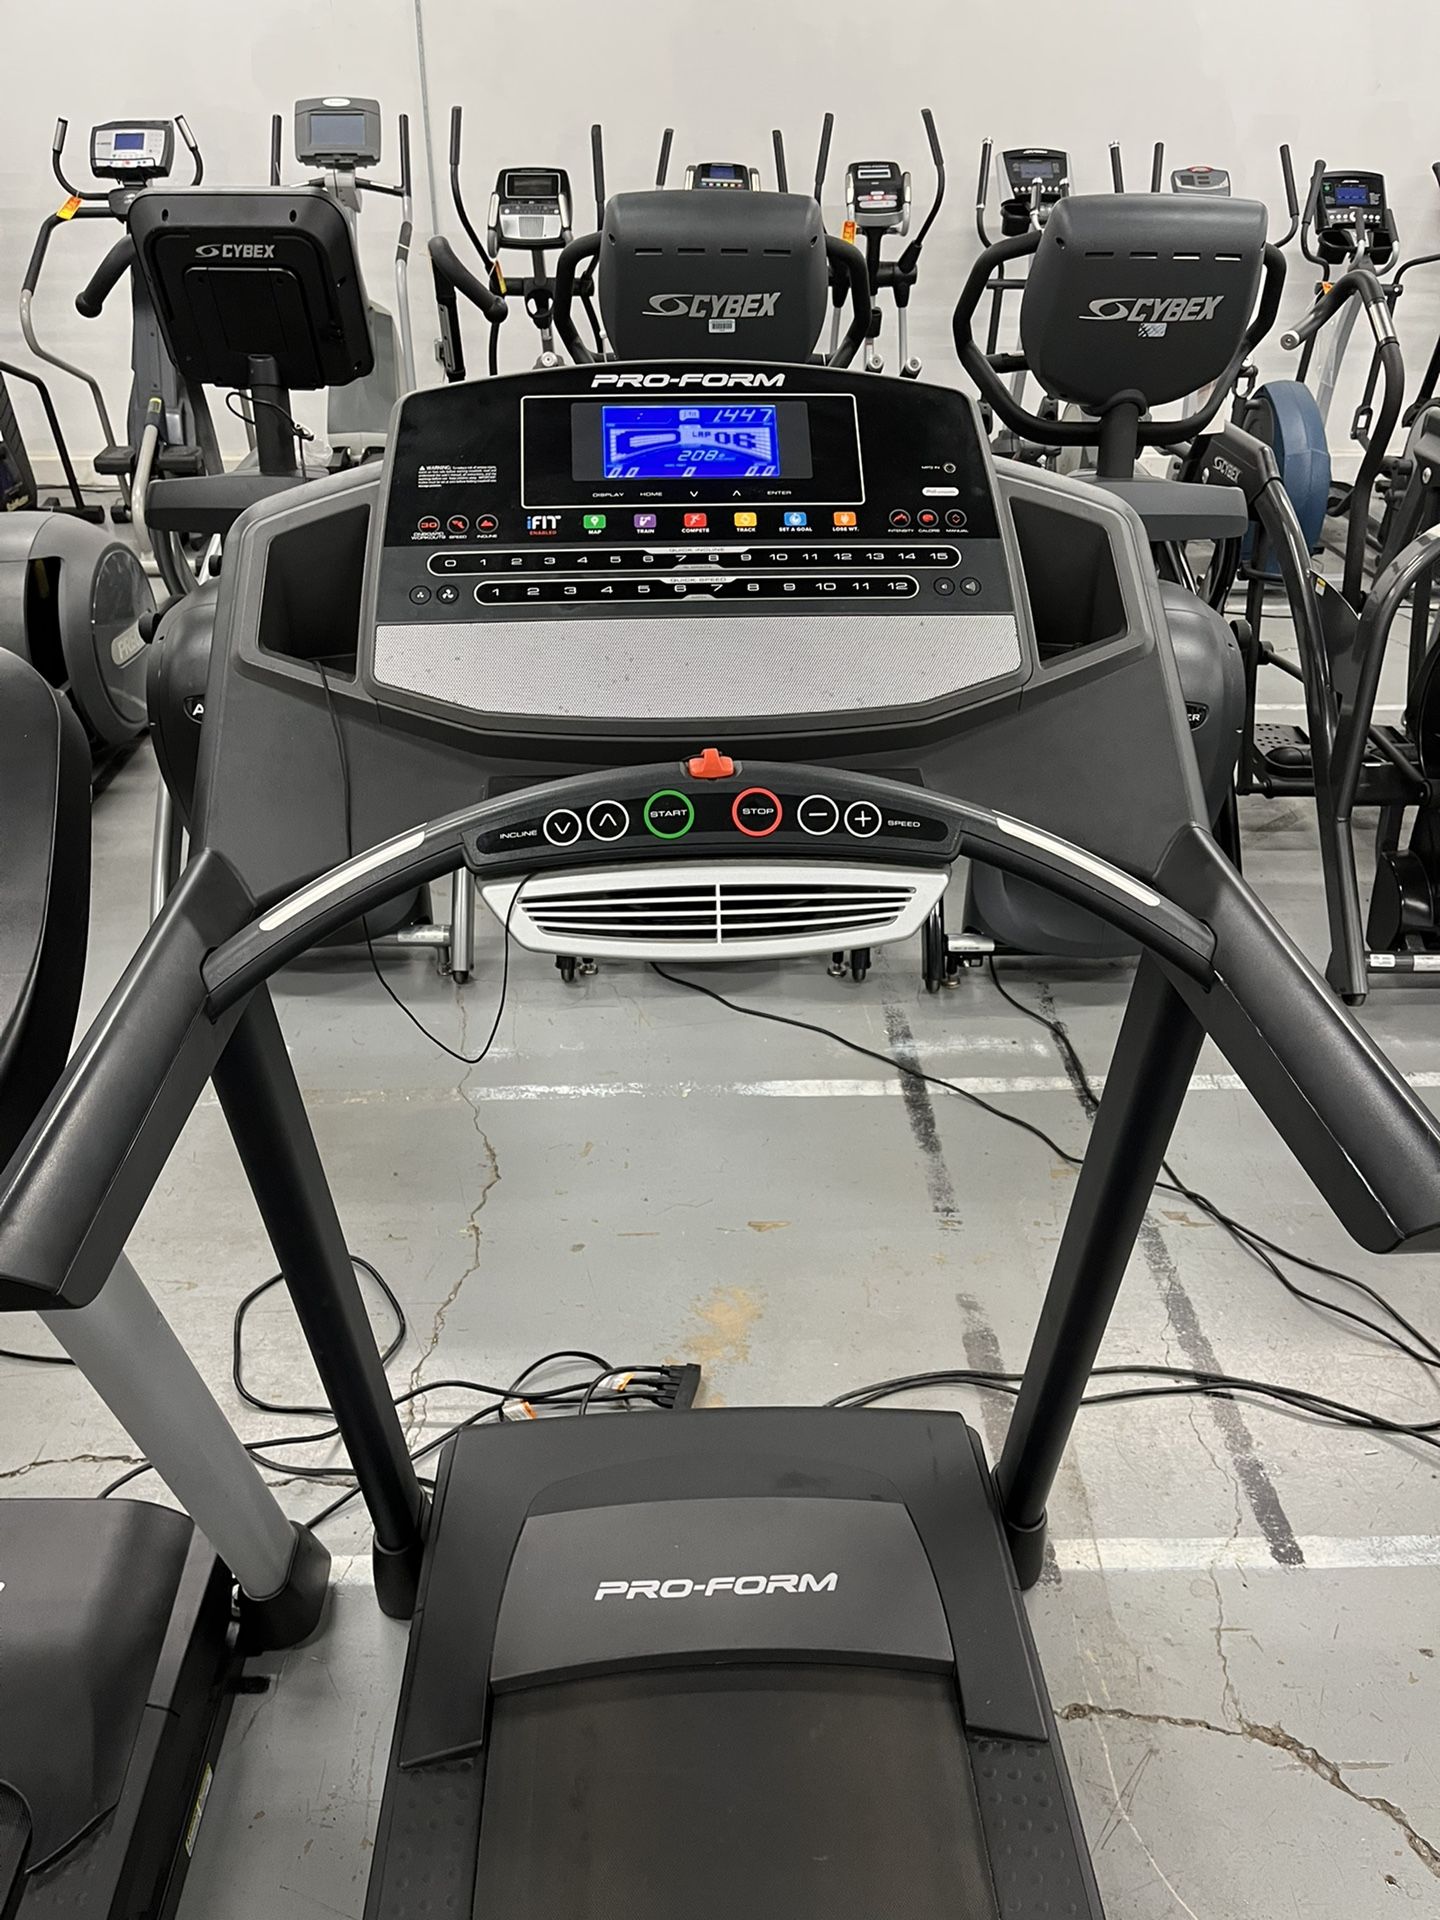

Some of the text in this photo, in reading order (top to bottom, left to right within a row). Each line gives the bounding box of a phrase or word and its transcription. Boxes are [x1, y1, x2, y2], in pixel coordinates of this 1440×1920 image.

[222, 244, 275, 258] CYBEX
[688, 292, 781, 318] CYBEX
[1127, 295, 1225, 322] CYBEX
[591, 373, 785, 388] PRO-FORM
[677, 450, 719, 461] 208
[607, 467, 640, 478] 0.0
[681, 466, 697, 477] 0
[744, 465, 776, 477] 0.0
[444, 559, 457, 568] 0
[510, 557, 523, 566] 2
[543, 556, 556, 565] 3
[576, 556, 588, 564] 4
[609, 555, 622, 564] 5
[642, 555, 654, 563] 6
[675, 554, 687, 562] 7
[708, 554, 720, 562] 8
[740, 553, 752, 562] 9
[769, 553, 788, 561] 10
[802, 553, 818, 561] 11
[833, 552, 853, 561] 12
[865, 552, 885, 561] 13
[898, 552, 916, 560] 14
[929, 552, 949, 560] 15
[491, 581, 908, 597] 1 2 3 4 5 6 7 8 9 10 11 12
[650, 809, 688, 819] START
[742, 807, 775, 815] STOP
[887, 819, 921, 828] SPEED
[499, 829, 538, 840] INCLINE
[594, 1572, 839, 1601] PRO-FORM
